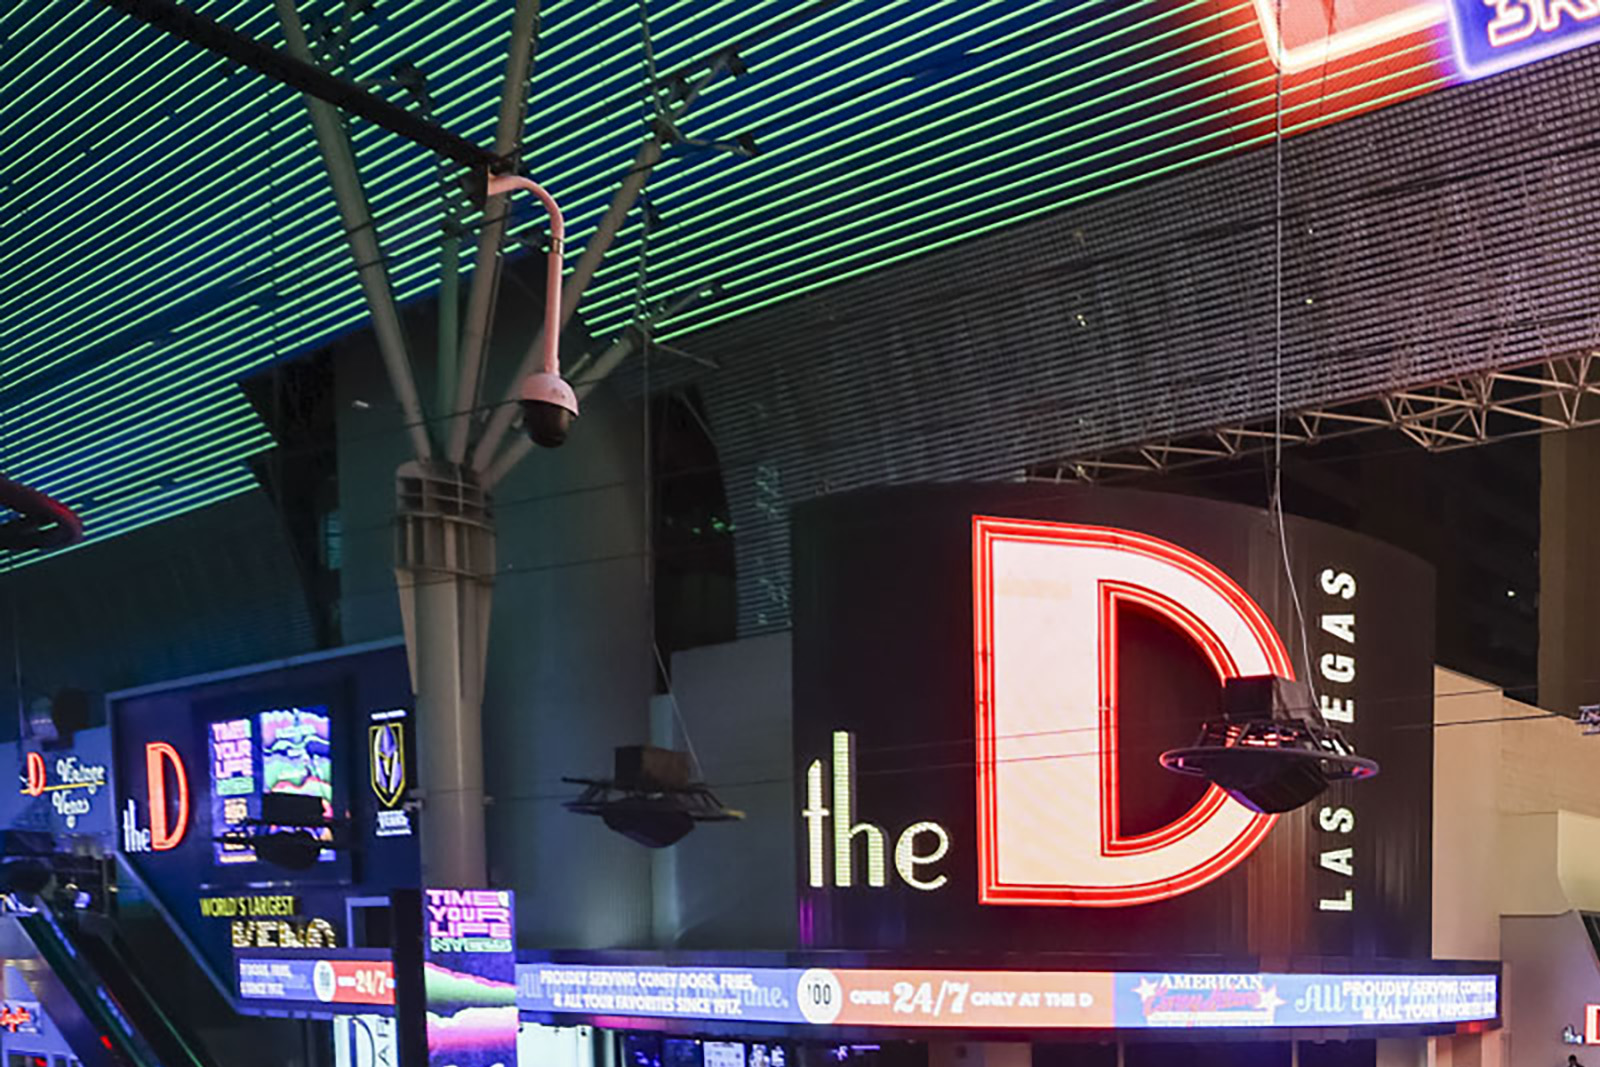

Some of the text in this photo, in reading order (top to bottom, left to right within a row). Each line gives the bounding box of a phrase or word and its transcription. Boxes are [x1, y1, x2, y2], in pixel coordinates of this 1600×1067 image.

[803, 515, 1298, 907] the D
[123, 799, 151, 852] the
[146, 742, 189, 850] D
[1320, 806, 1354, 911] LAS
[248, 896, 295, 917] LARGEST
[427, 905, 512, 922] YOUR
[430, 922, 512, 938] LIFE
[355, 970, 387, 996] 24/7
[540, 970, 586, 986] PROUDLY
[589, 971, 636, 988] SERVING
[638, 973, 679, 988] CONEY
[680, 973, 717, 990] DOGS,
[720, 974, 757, 992] FRIES,
[1160, 973, 1264, 989] AMERICAN
[1342, 980, 1411, 997] PROUDLY
[563, 994, 582, 1009] ALL
[584, 994, 614, 1010] YOUR
[616, 996, 675, 1012] FAVORITES
[677, 997, 711, 1013] SINCE
[849, 980, 1094, 1017] OPEN 24/7 ONLY AT THE D
[1377, 1003, 1402, 1019] ALL
